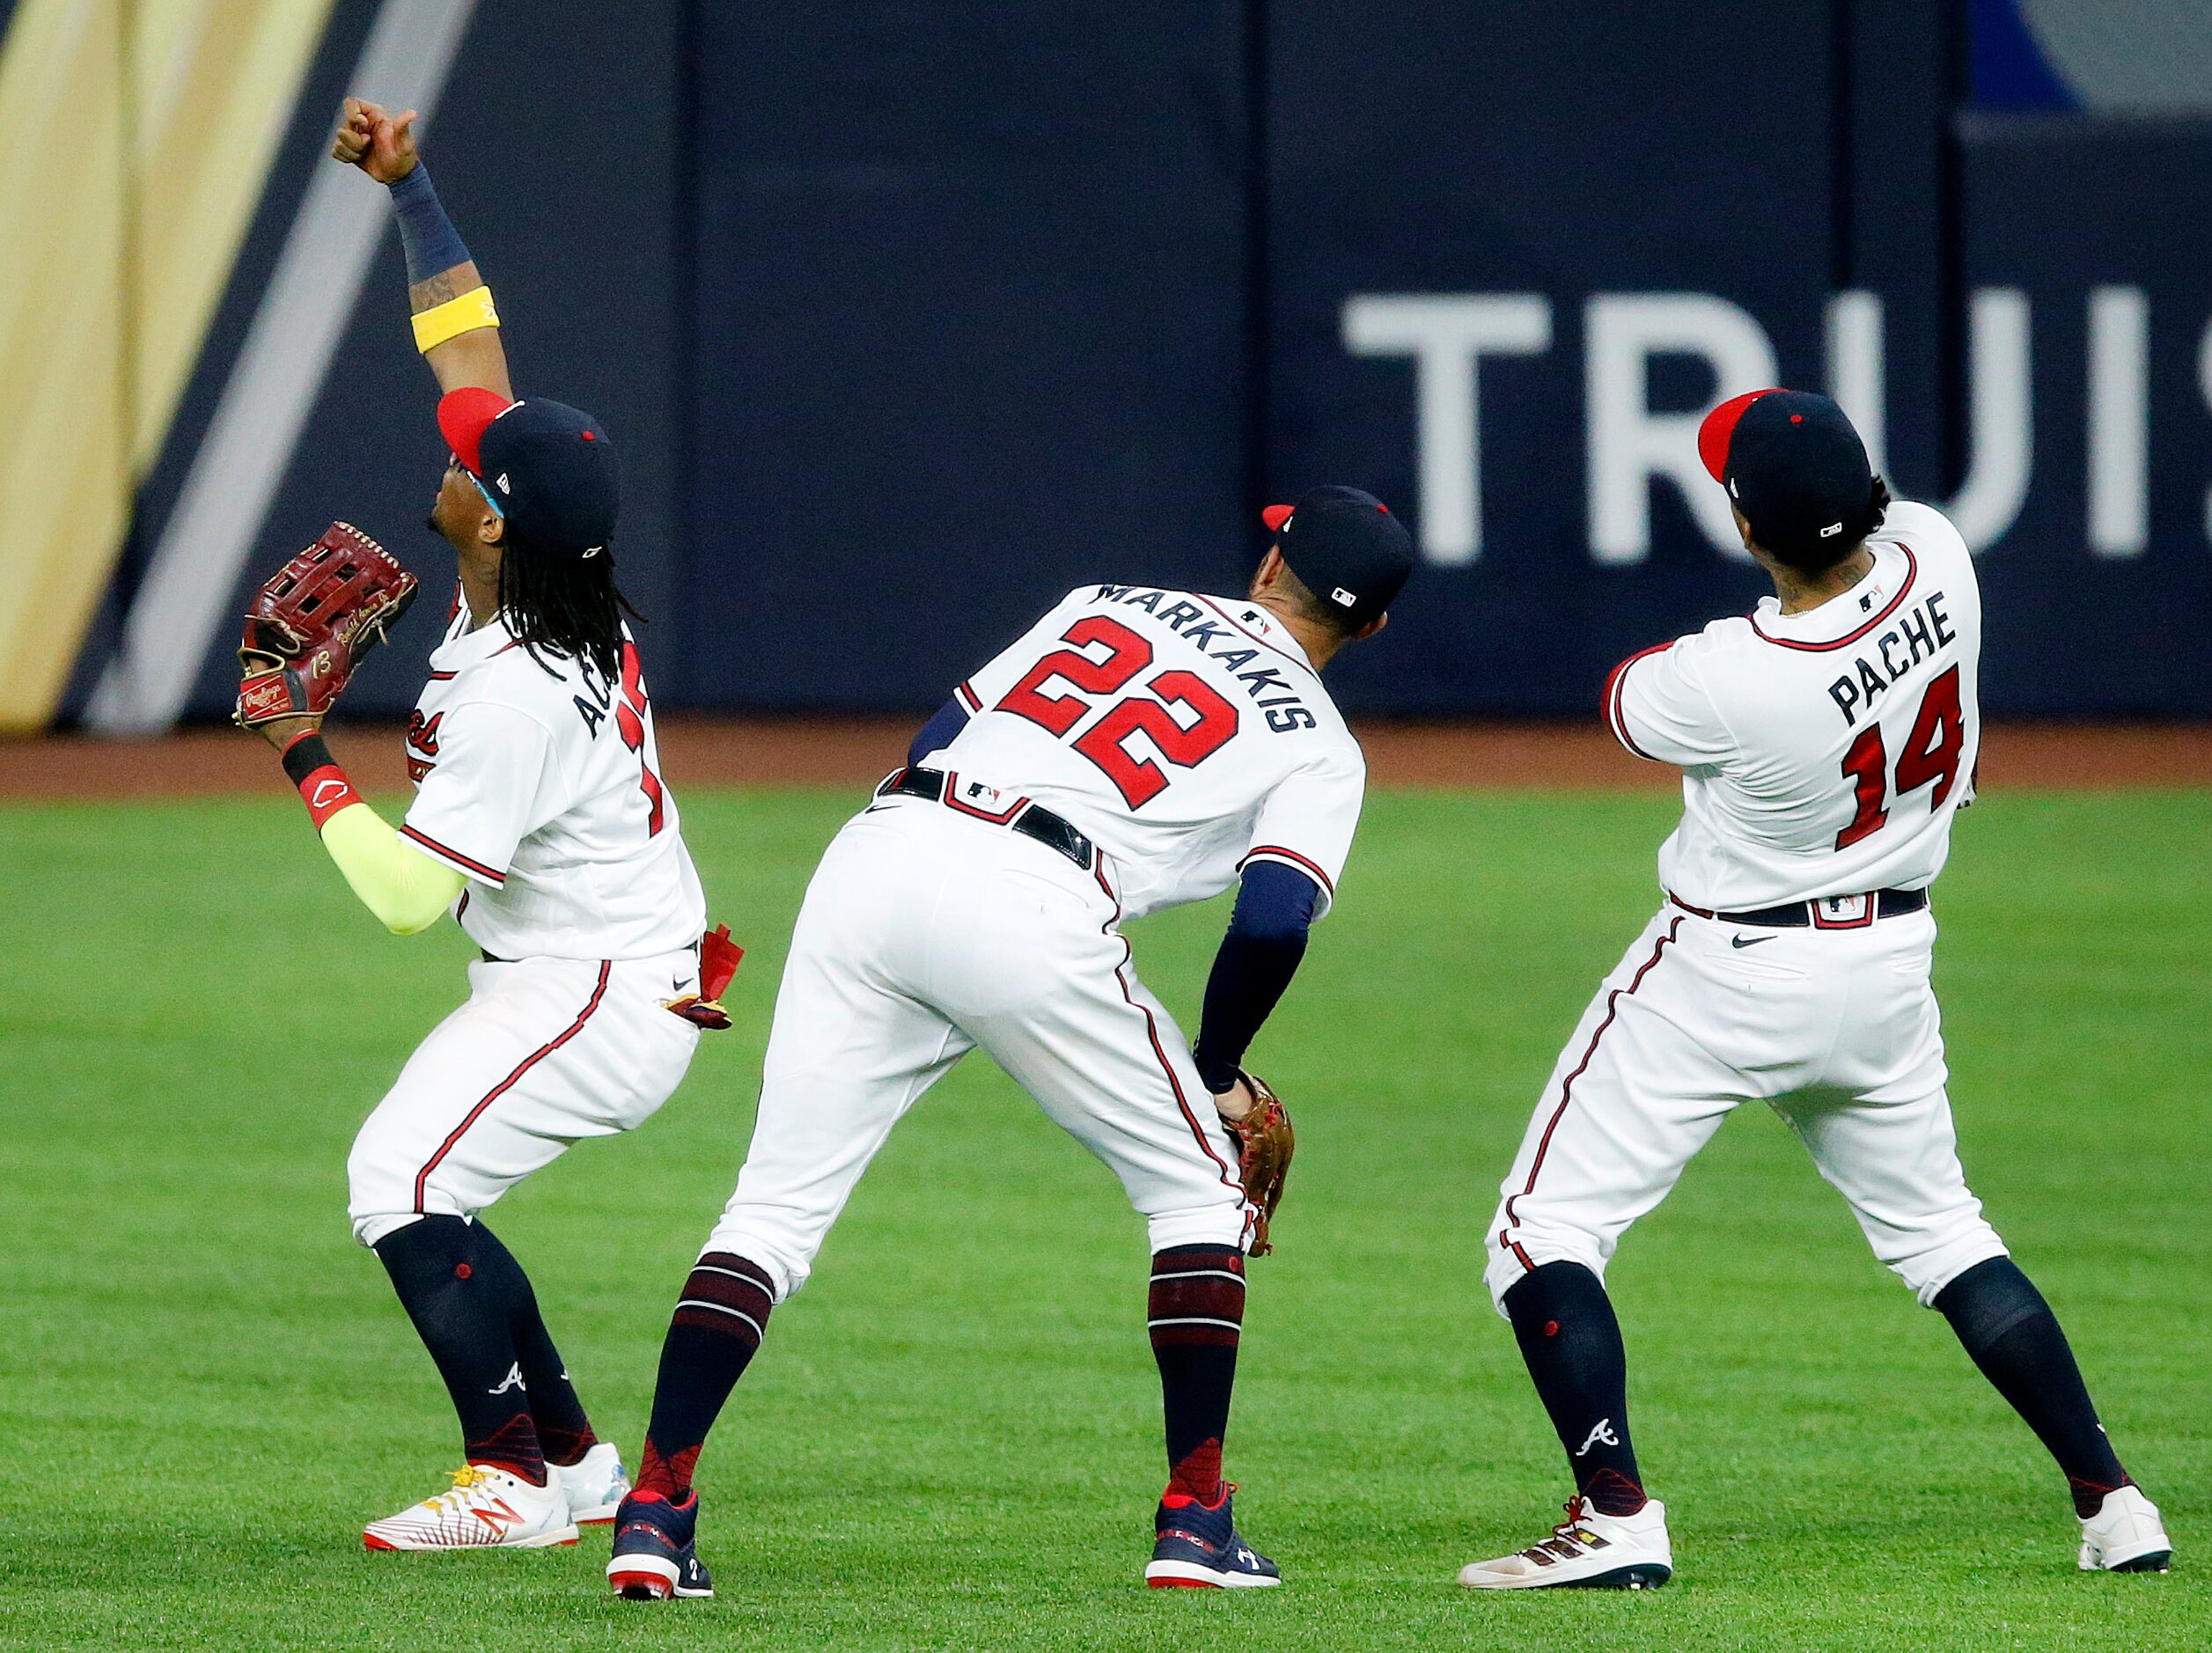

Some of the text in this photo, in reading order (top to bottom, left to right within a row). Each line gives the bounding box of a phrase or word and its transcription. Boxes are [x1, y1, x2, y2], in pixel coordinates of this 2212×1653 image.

[1342, 287, 2212, 564] TRUI
[246, 685, 282, 708] Rawlings
[310, 650, 332, 680] 13
[572, 662, 612, 741] AC
[992, 614, 1240, 812] 22
[1087, 584, 1317, 733] MARKAKIS
[1828, 591, 1956, 727] PACHE
[1834, 662, 1965, 852] 14
